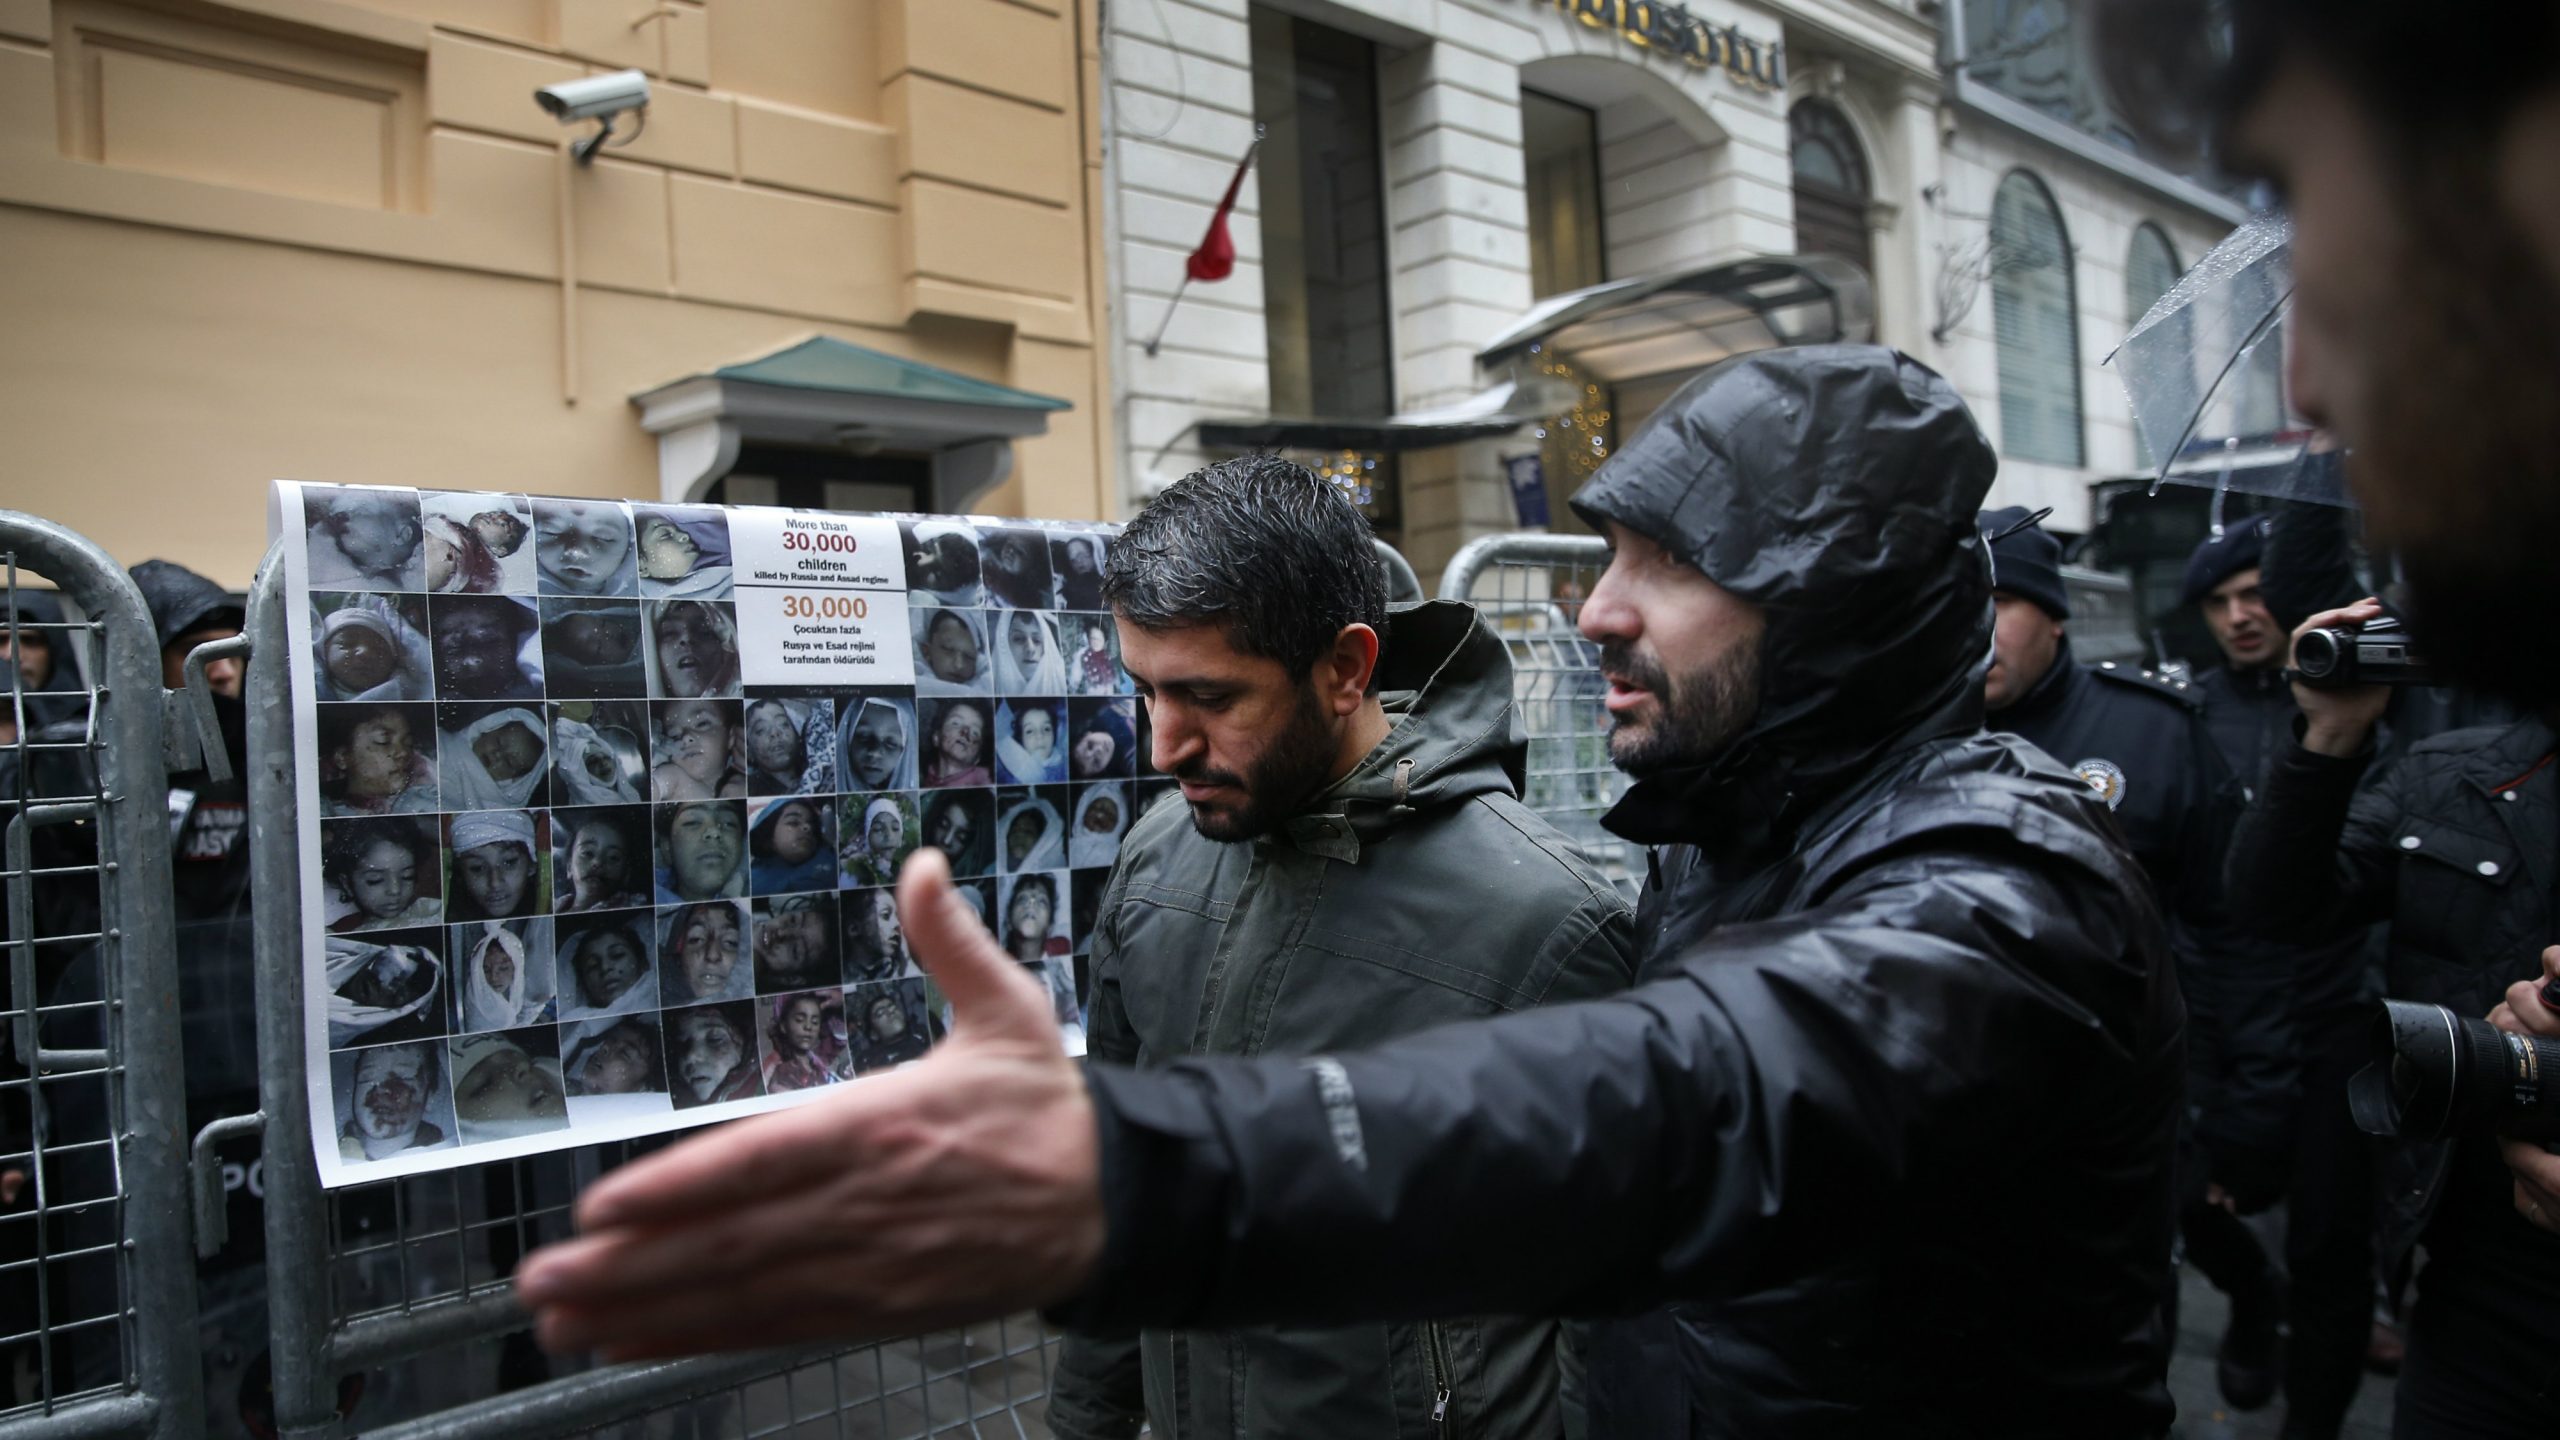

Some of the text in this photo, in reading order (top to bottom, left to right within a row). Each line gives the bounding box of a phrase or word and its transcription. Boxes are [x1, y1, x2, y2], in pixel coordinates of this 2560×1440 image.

[785, 518, 848, 532] More than
[782, 531, 857, 555] 30,000
[798, 558, 847, 571] children
[754, 571, 889, 585] killed by Russia and Assad regime
[783, 595, 868, 622] 30,000
[794, 624, 861, 635] Çocuktan fazla
[783, 640, 875, 653] Rusya ve Esad rejimi
[783, 655, 875, 665] tarafından öldürüldü
